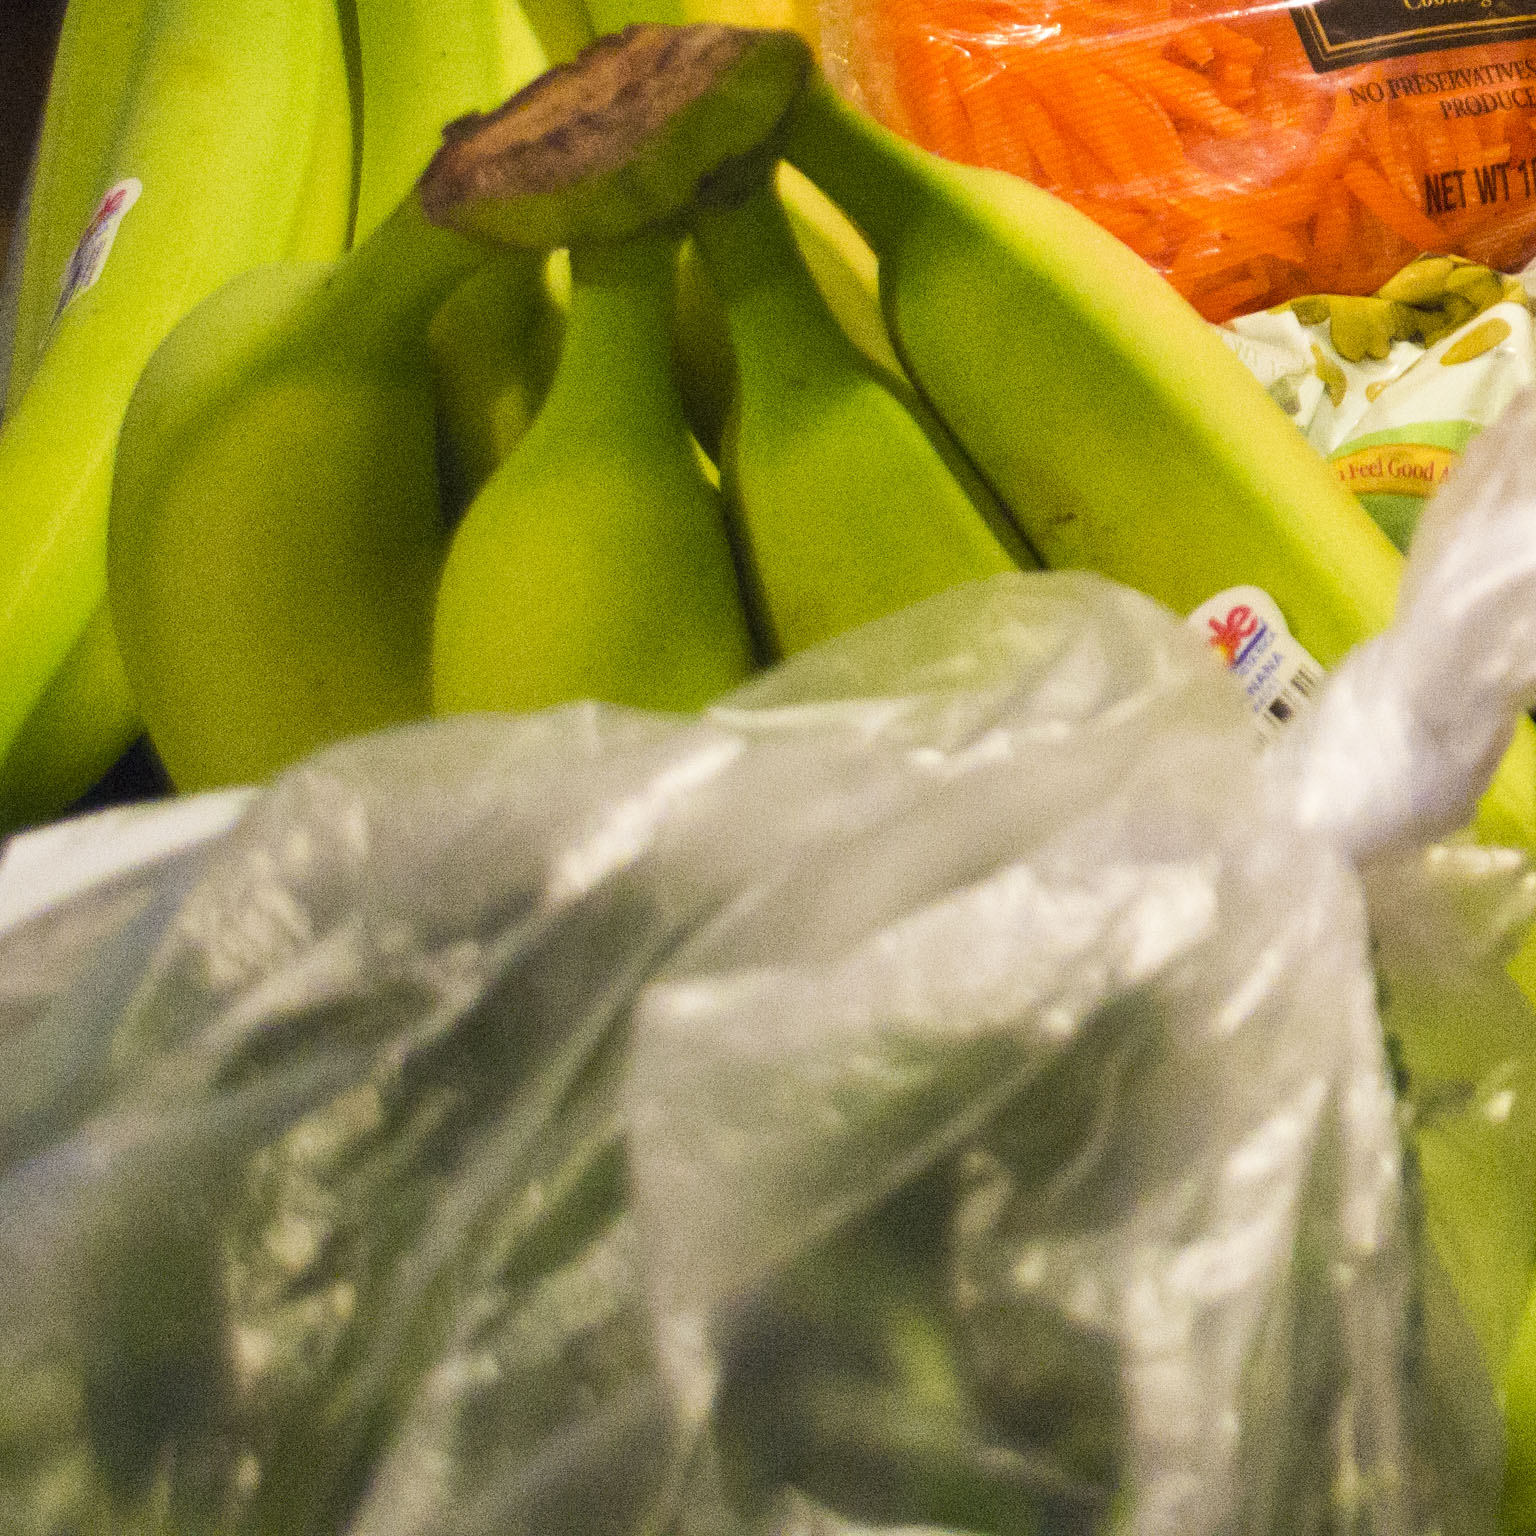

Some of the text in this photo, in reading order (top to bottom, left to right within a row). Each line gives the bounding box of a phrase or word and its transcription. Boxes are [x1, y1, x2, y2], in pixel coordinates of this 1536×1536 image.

[1350, 81, 1385, 107] NO
[1424, 169, 1468, 216] NET
[1473, 161, 1511, 206] WT
[1348, 456, 1435, 482] Feel Good
